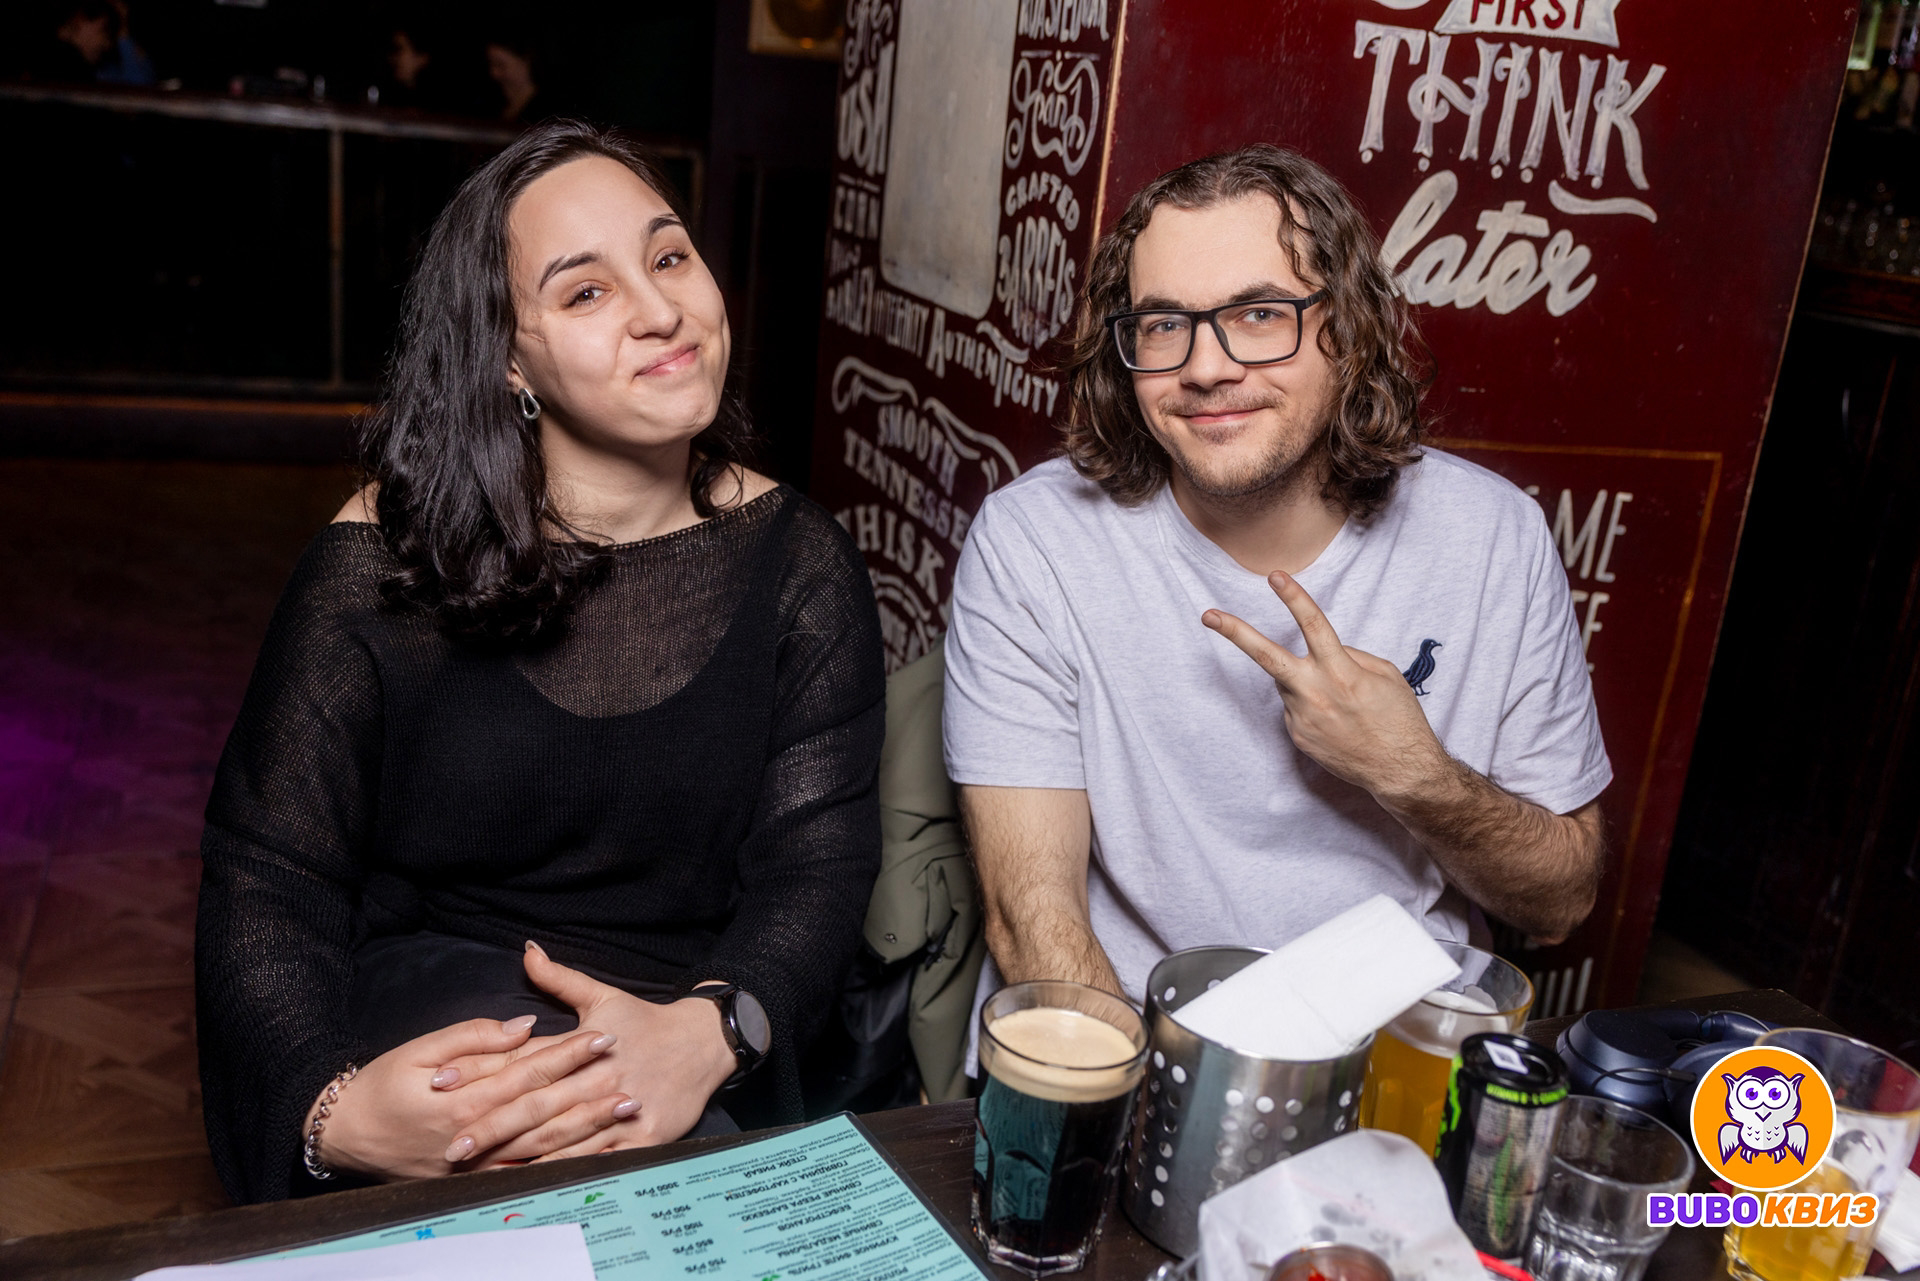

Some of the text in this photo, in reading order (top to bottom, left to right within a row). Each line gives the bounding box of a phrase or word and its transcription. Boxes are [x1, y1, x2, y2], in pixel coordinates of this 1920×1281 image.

[1353, 20, 1667, 190] THINK
[1005, 171, 1080, 232] CRAFTED
[1380, 170, 1597, 317] later
[926, 307, 1060, 418] AUTHENTICITY
[877, 403, 961, 495] SMOOTH
[1553, 488, 1634, 583] ME
[834, 505, 950, 618] HISK
[742, 1154, 808, 1178] СТЕЙК РИБАЙ
[797, 1159, 848, 1179] ГОВЯДИНА
[634, 1187, 655, 1197] РУБ
[656, 1180, 679, 1192] 3000
[723, 1177, 789, 1201] КАРТОФЕЛЕМ
[650, 1204, 691, 1219] 900 РУБ
[740, 1180, 862, 1222] СВИНЫЕ РЕБРА БАРБЕКЮ
[776, 1203, 851, 1231] БЕФСТРОГАНОВ
[660, 1226, 682, 1237] РУБ
[776, 1218, 883, 1258] СВИНЫЕ МЕДАЛЬОНЫ
[672, 1243, 694, 1254] РУБ
[851, 1235, 899, 1255] КУРИНОЕ
[787, 1260, 821, 1276] ГРИЛЬ
[822, 1250, 852, 1265] ФИЛЕ
